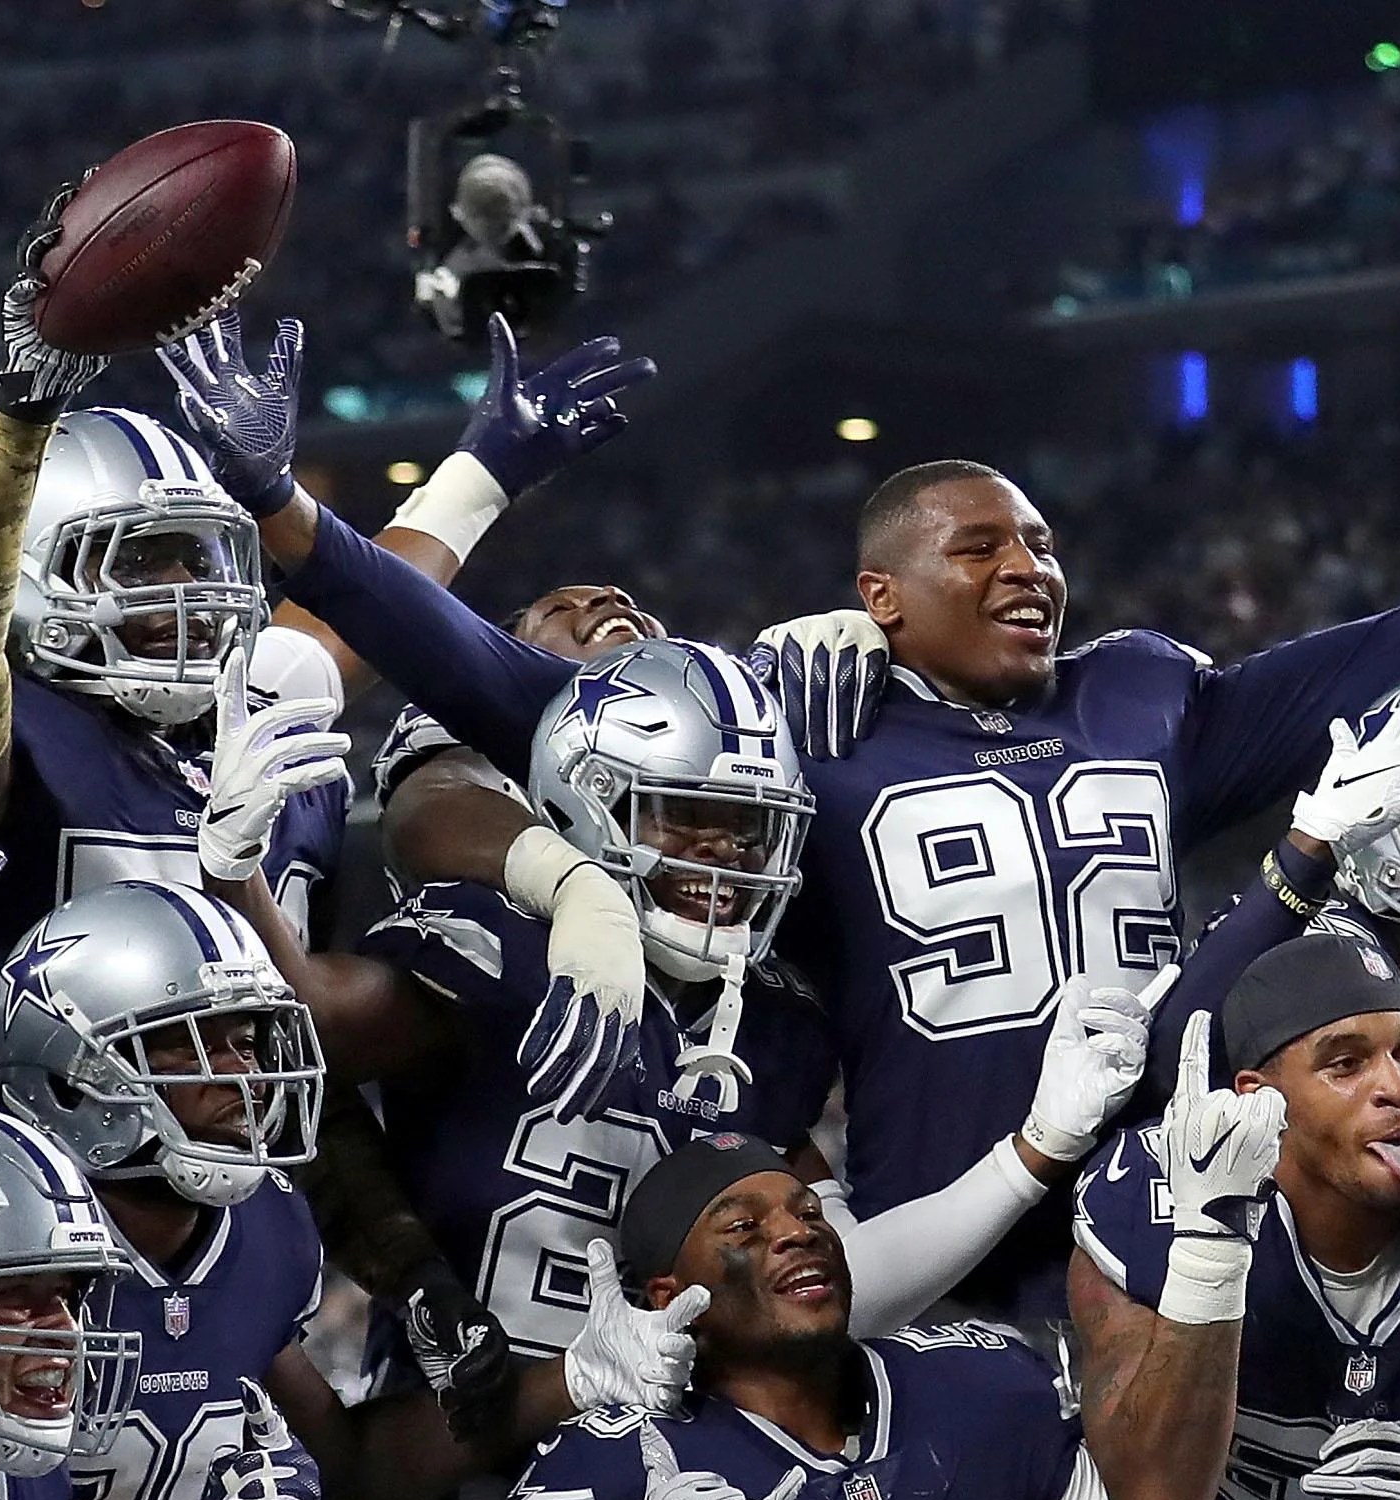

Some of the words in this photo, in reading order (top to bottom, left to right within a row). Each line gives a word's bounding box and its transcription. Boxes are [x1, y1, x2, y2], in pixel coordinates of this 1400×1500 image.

[974, 738, 1064, 767] COWBOYS
[861, 760, 1181, 1042] 92
[140, 1371, 209, 1393] COWBOYS
